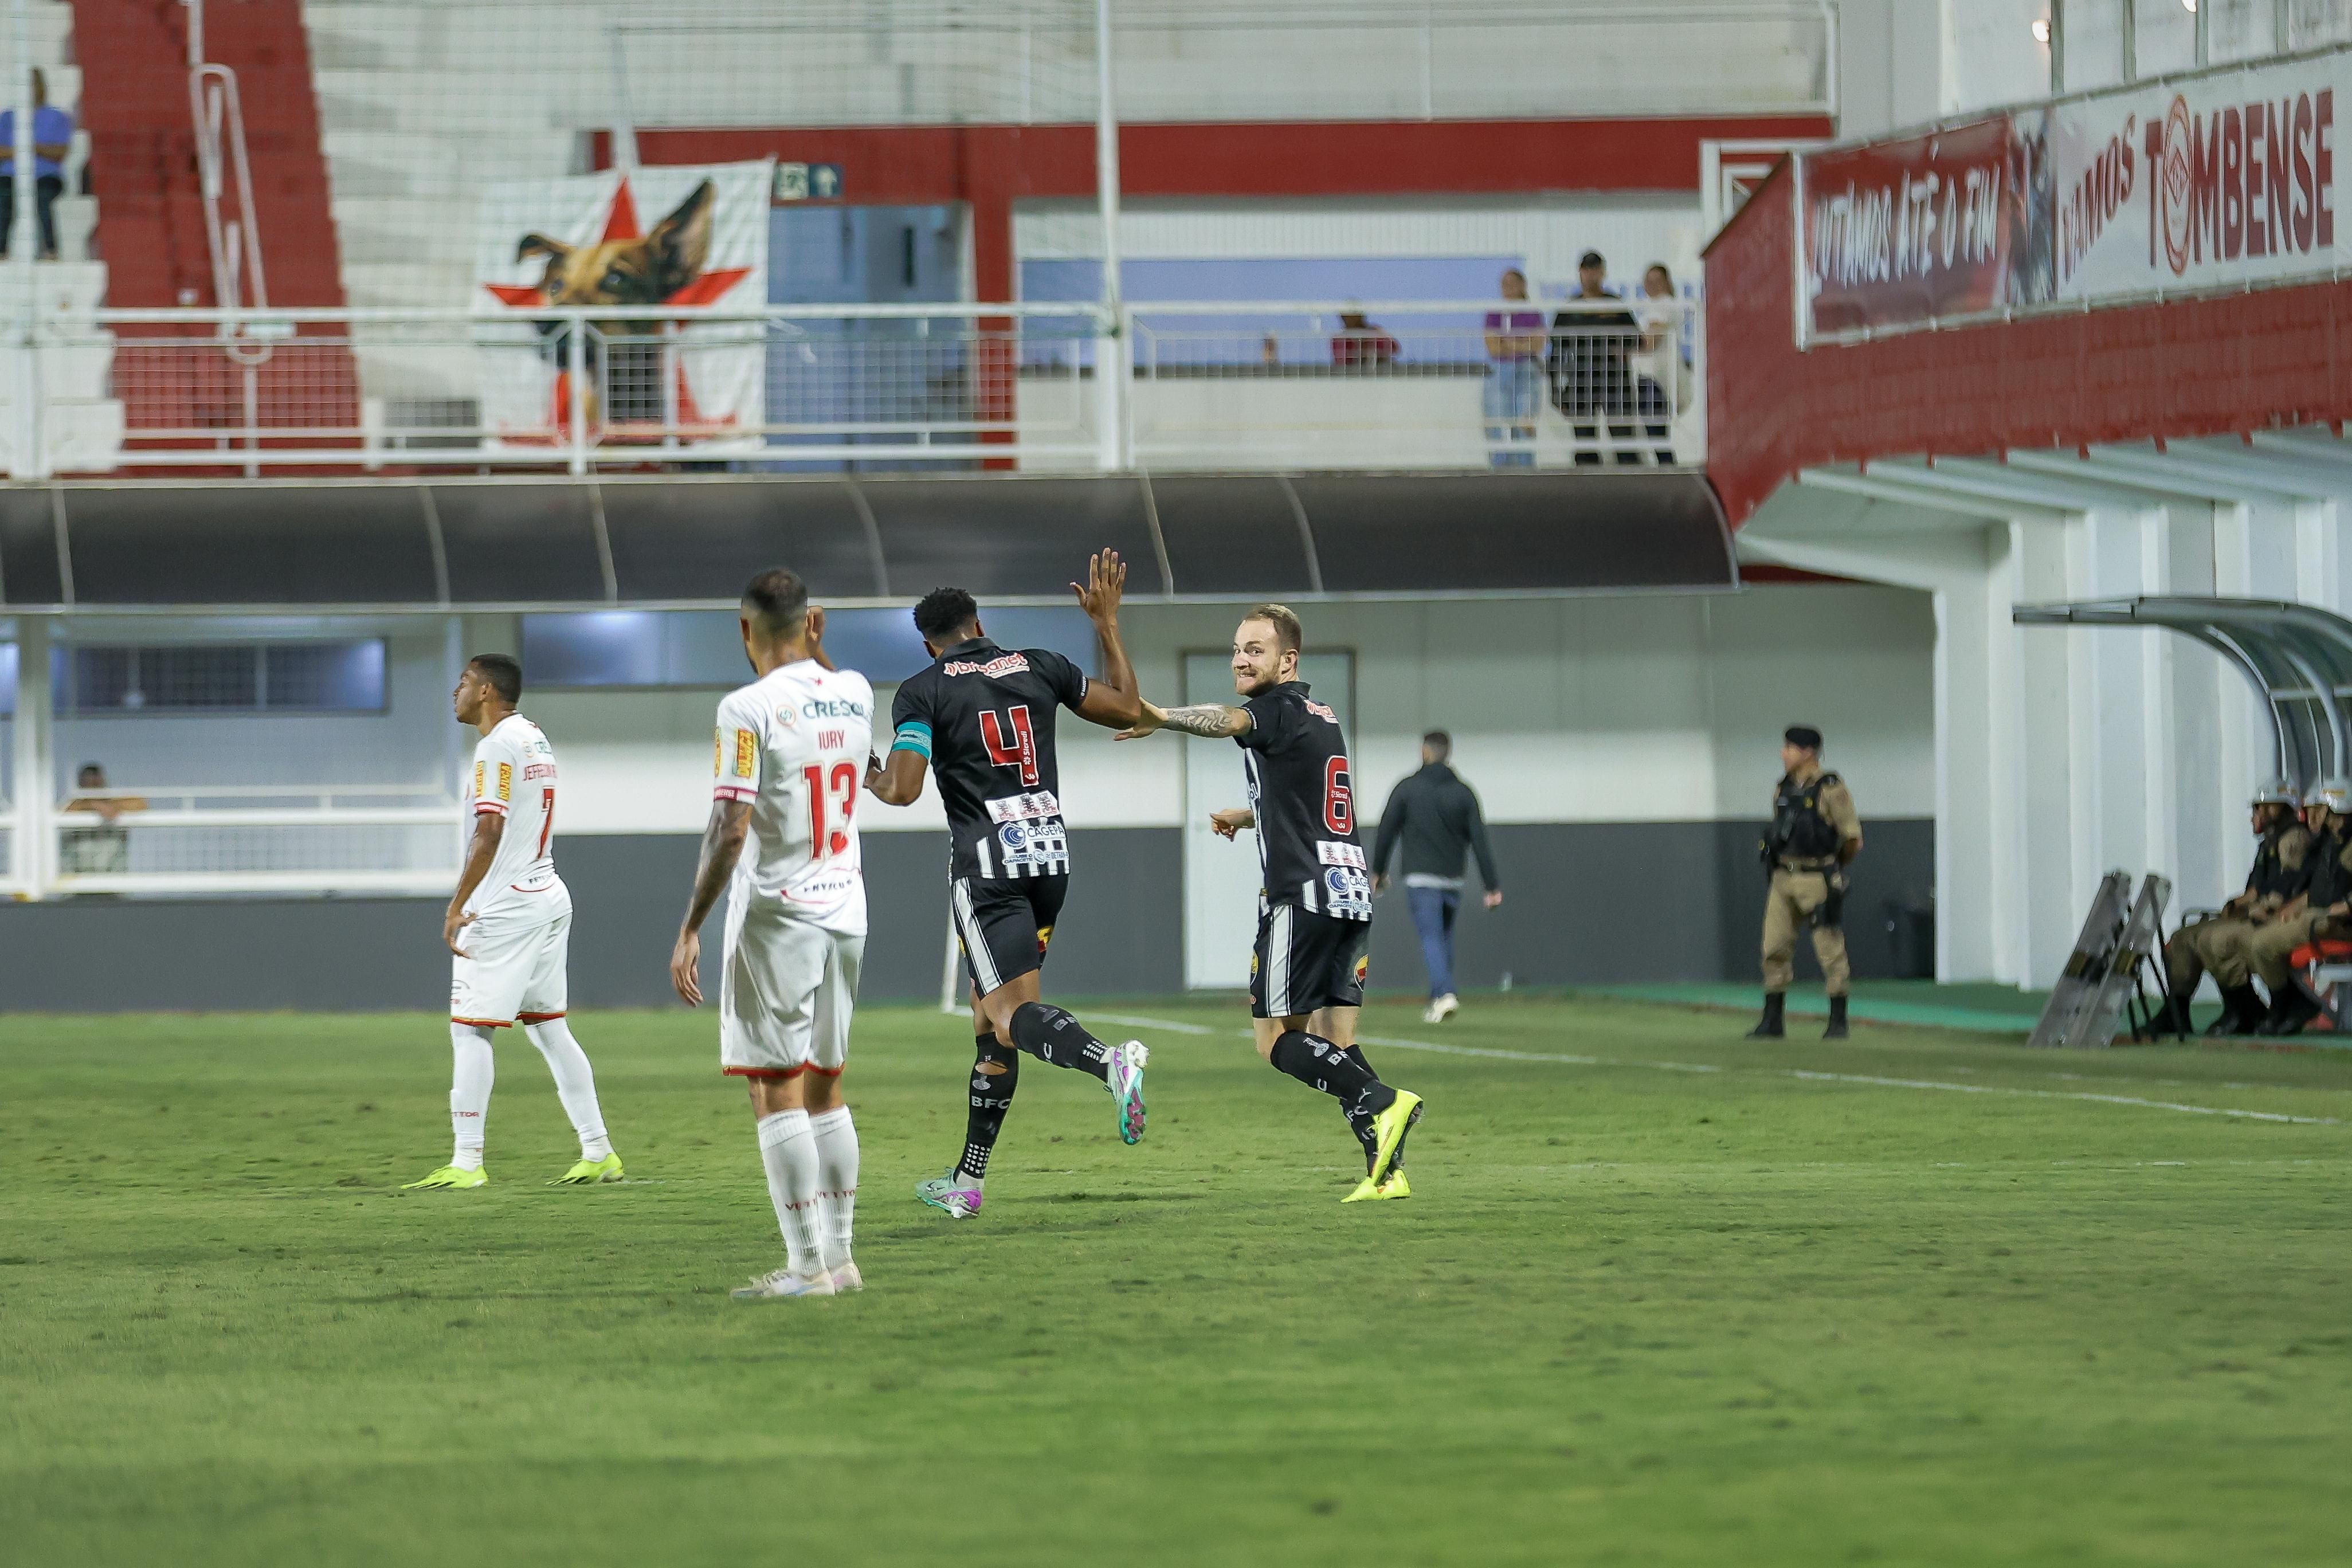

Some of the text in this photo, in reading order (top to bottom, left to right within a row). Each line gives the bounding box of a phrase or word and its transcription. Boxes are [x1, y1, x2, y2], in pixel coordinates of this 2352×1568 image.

[1941, 174, 1957, 270] O
[1962, 163, 2001, 268] FIM
[2063, 88, 2334, 283] VAMOS TOMBENSE
[957, 652, 1028, 675] brisanet
[818, 729, 845, 751] IURY
[978, 705, 1038, 787] 4
[538, 786, 555, 861] 7
[802, 761, 859, 861] 13
[1027, 826, 1065, 838] CAGEPA
[1324, 755, 1353, 836] 6
[971, 1095, 1011, 1110] BFC
